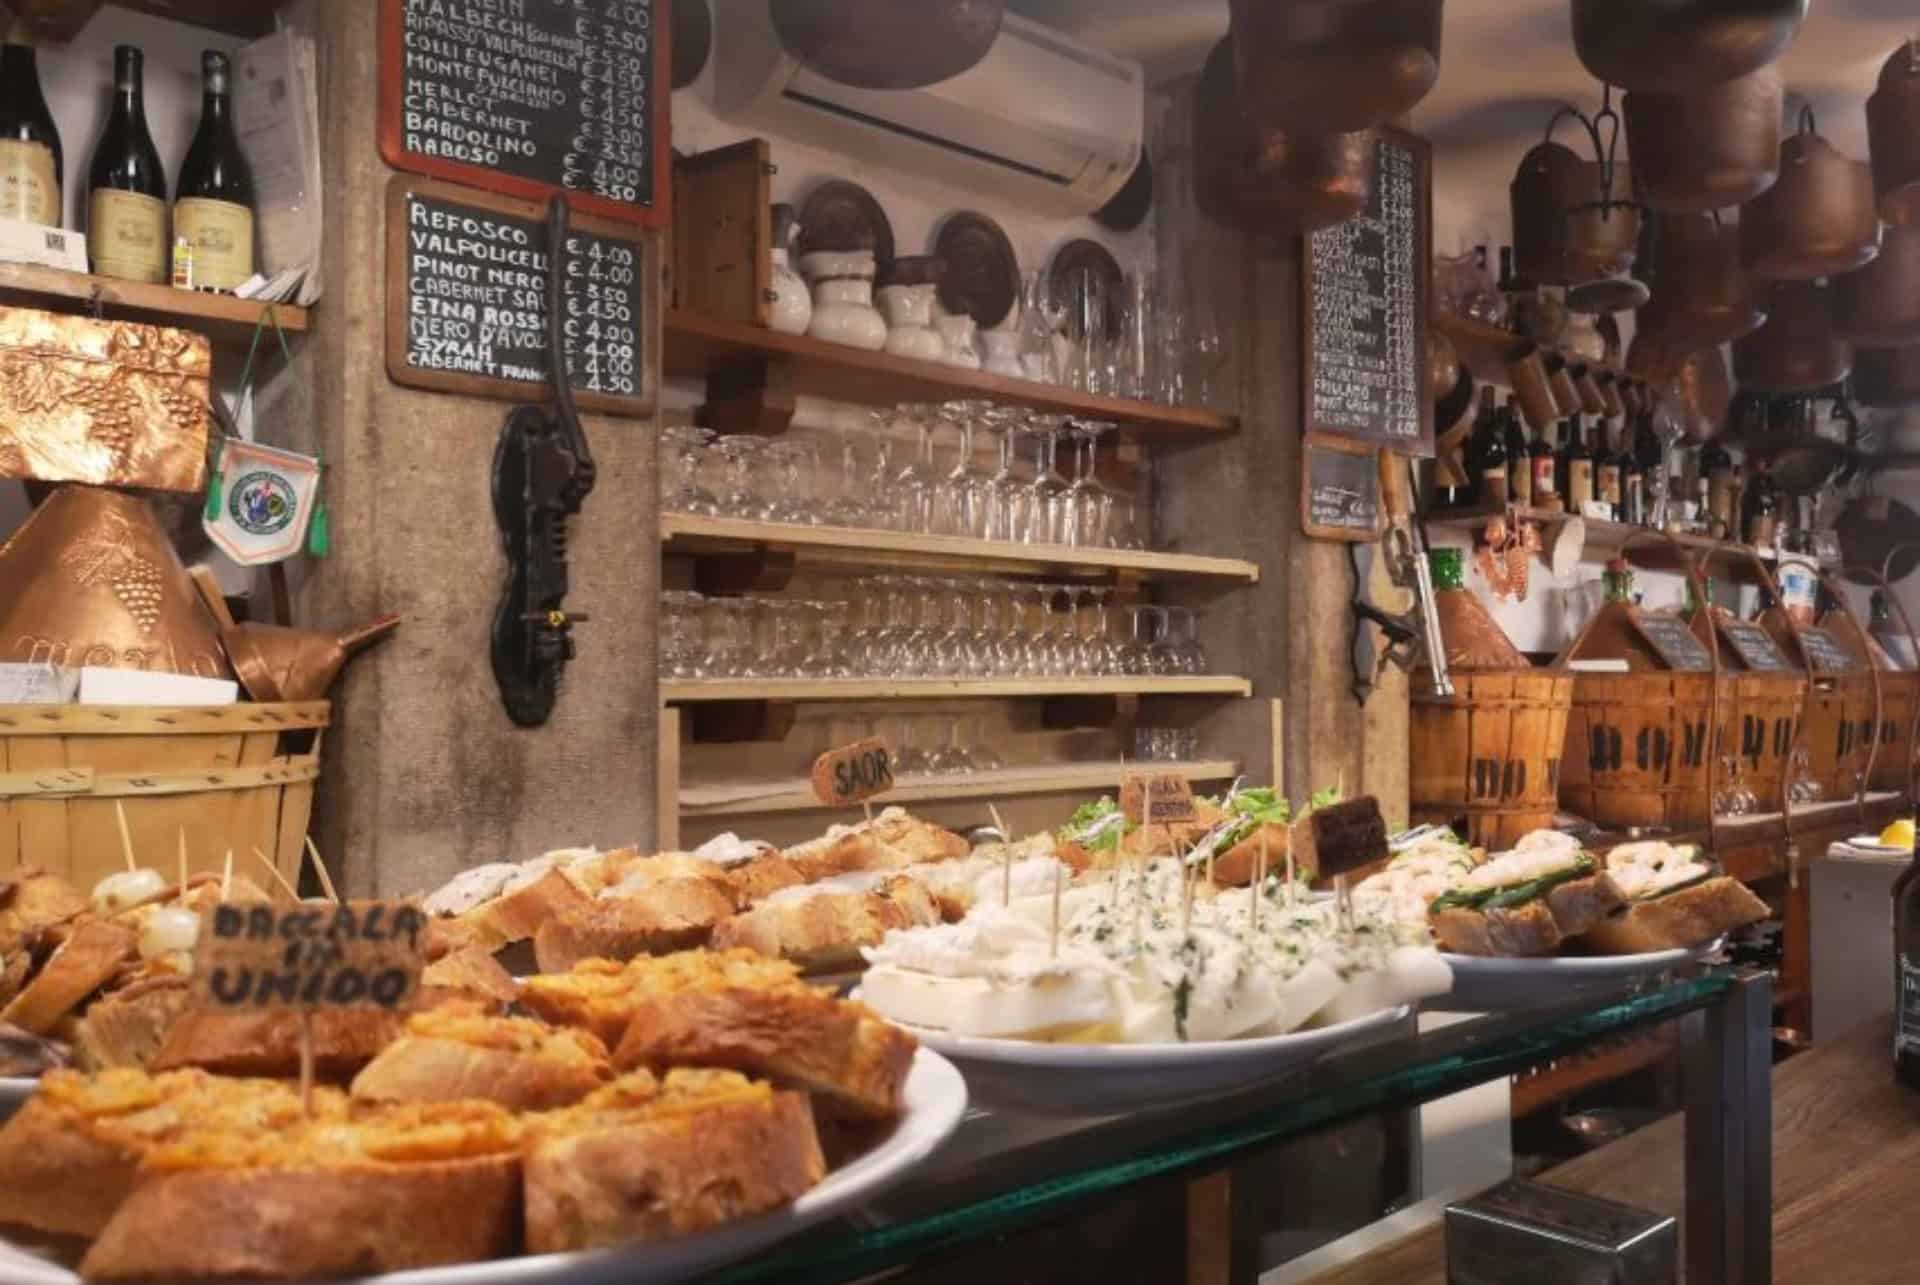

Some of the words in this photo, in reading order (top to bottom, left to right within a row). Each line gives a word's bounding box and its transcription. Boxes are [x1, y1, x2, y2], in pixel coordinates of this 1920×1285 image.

[405, 31, 460, 60] COLLI
[407, 78, 493, 111] MERLOT
[405, 95, 531, 135] CABERNET
[406, 111, 537, 157] BARDOLINO
[406, 132, 499, 165] RABOSO
[410, 201, 528, 246] REFOSCO
[588, 242, 633, 265] 4.00
[410, 229, 549, 273] VALPOLICELL
[588, 262, 633, 285] 4.00
[413, 254, 480, 281] PINOT
[487, 268, 545, 290] NERO
[409, 276, 507, 305] CABERNET
[410, 315, 470, 342] NERO
[480, 323, 547, 349] D'AVOL
[584, 341, 633, 360] 4.00
[411, 294, 477, 323] ETNA
[585, 320, 634, 344] 4.00
[407, 352, 497, 375] CABERNET
[413, 337, 493, 361] SYRAH
[585, 358, 633, 376] 4.00
[836, 748, 893, 796] SAOR
[210, 966, 408, 1007] UMIDO
